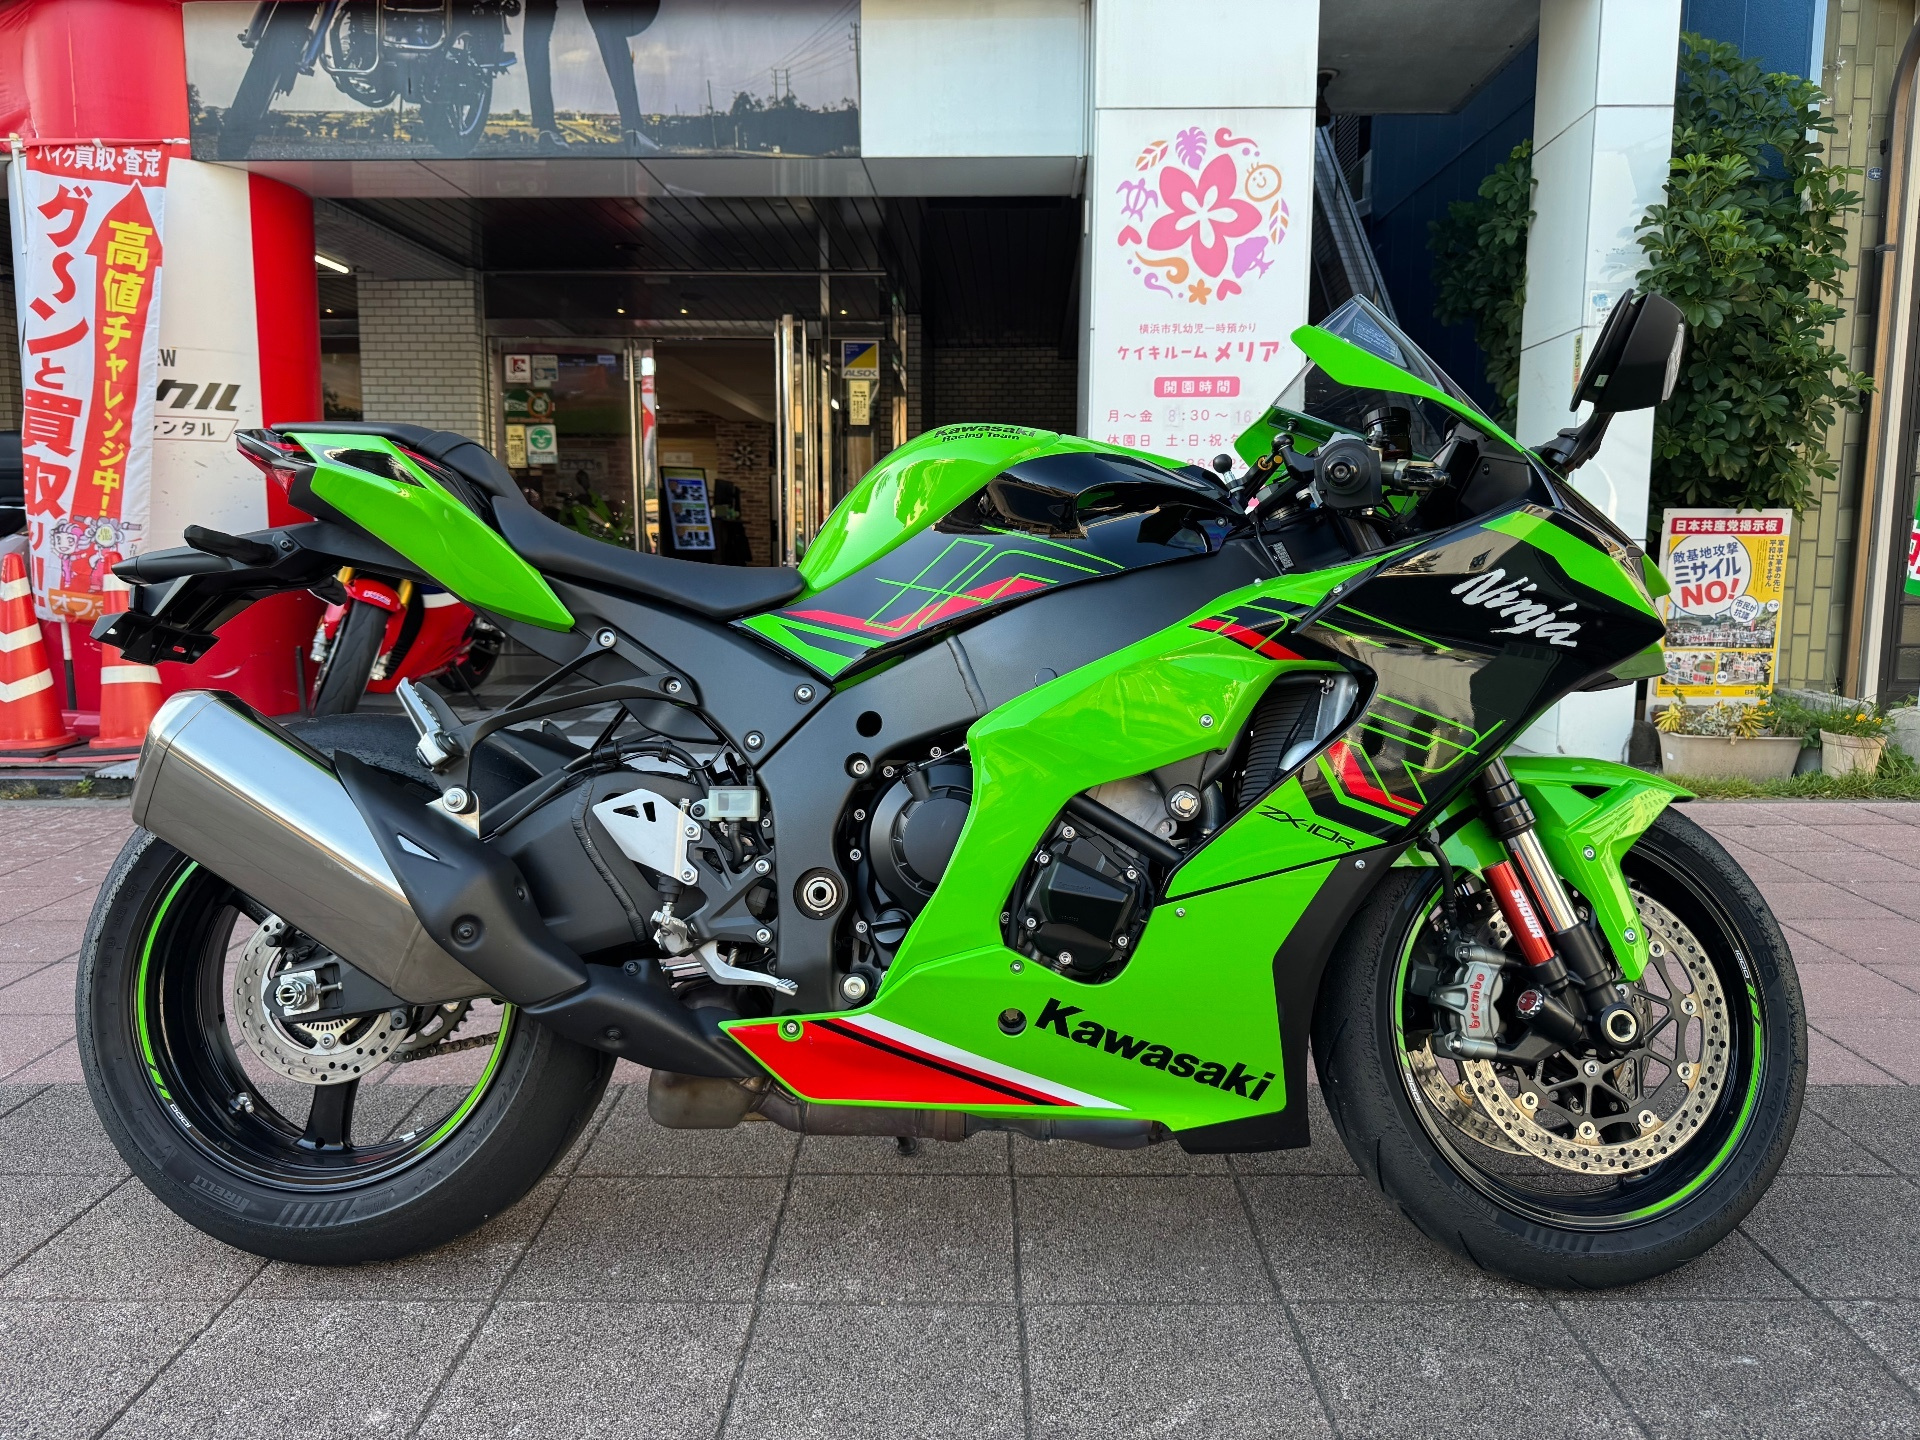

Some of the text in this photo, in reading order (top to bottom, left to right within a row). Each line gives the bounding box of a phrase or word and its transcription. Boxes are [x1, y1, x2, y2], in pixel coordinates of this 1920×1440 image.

[1138, 322, 1257, 335] 横浜市乳幼児一時預かり
[1163, 380, 1231, 395] 開園時間
[154, 421, 215, 437] ンタル
[934, 425, 1037, 439] Kawasaki
[941, 432, 1020, 443] Racing Team
[1675, 520, 1779, 532] 日本共産党掲示板
[1673, 542, 1739, 564] 敵基地攻撃
[1674, 557, 1742, 585] ミサイル
[1680, 578, 1740, 608] NO!
[1735, 600, 1757, 612] 市民が
[1450, 568, 1582, 648] Ninja
[1733, 609, 1751, 621] 抗議
[1256, 805, 1356, 850] ZX-10R
[1510, 889, 1544, 940] SHOWA
[1734, 949, 1752, 980] 1000
[1468, 973, 1486, 1030] brembo
[1034, 997, 1276, 1102] Kawasaki
[1405, 1072, 1423, 1104] 1000
[169, 1103, 191, 1129] 1000
[189, 1174, 250, 1213] PIRELLI
